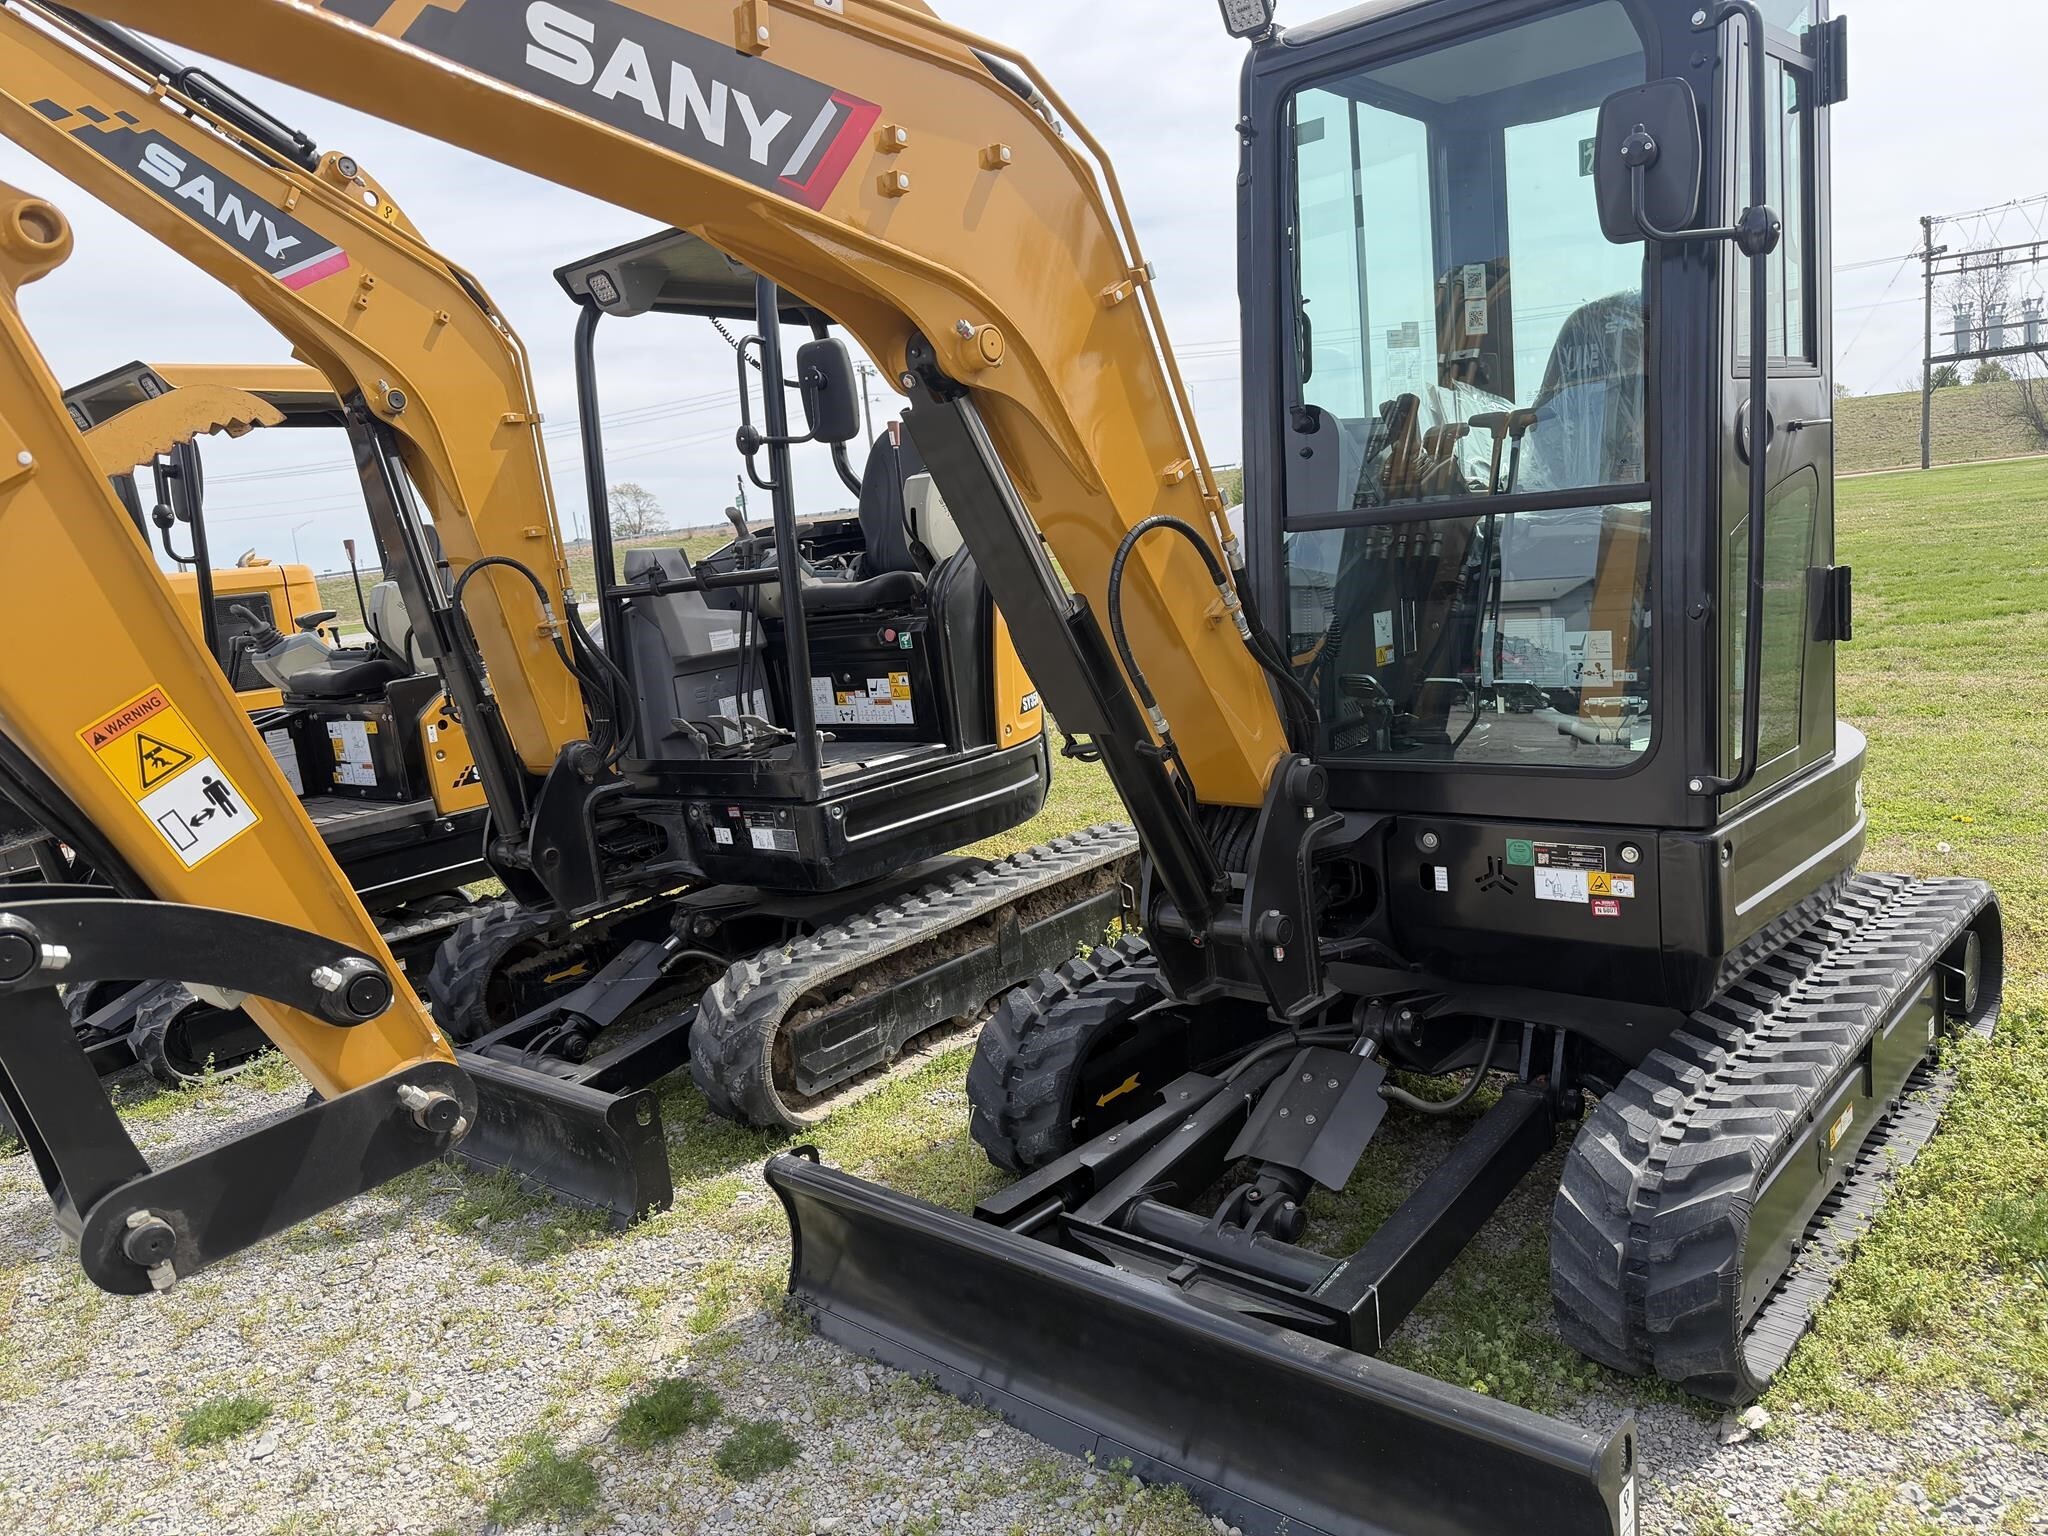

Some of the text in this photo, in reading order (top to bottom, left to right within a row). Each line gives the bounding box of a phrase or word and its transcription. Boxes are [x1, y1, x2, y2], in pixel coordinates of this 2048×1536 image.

[526, 1, 792, 165] SANY
[138, 143, 301, 259] SANY
[104, 696, 161, 735] WARNING
